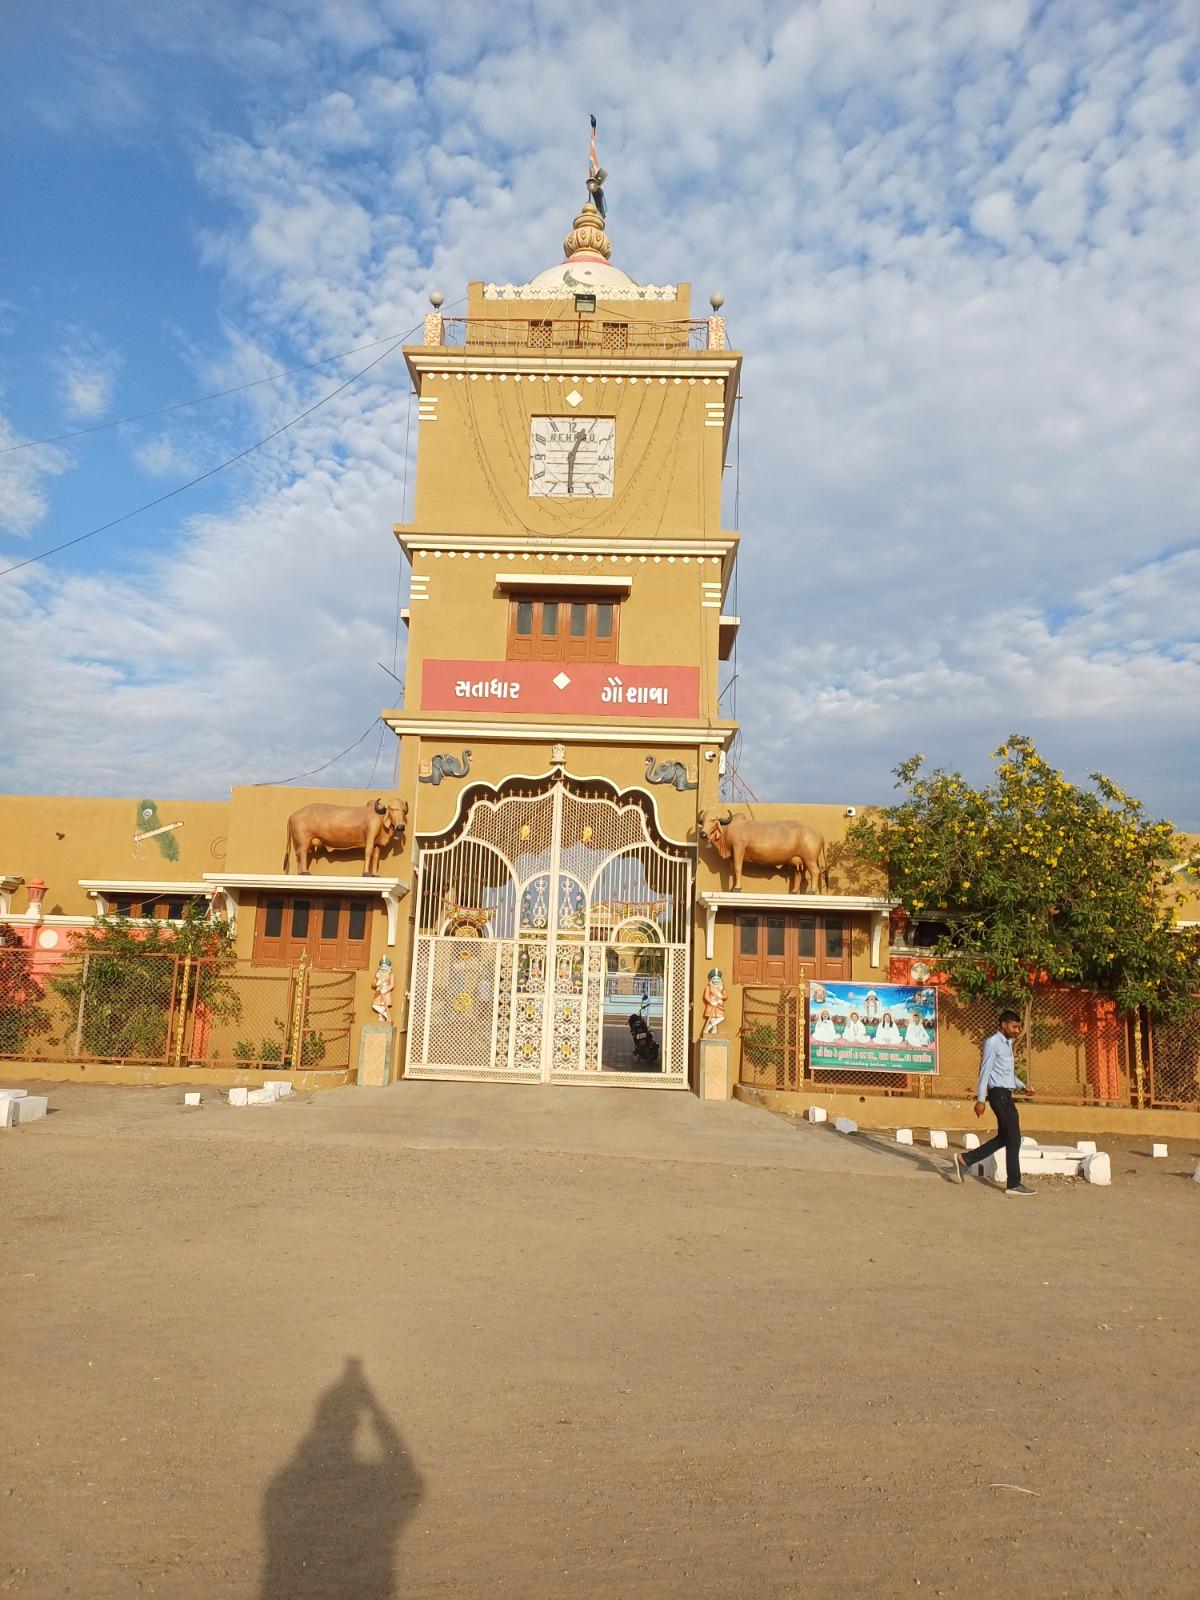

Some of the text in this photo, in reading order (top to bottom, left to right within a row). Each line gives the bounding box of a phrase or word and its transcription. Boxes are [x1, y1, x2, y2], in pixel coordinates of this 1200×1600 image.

[568, 422, 577, 433] 12
[550, 433, 595, 442] NEHU
[598, 472, 610, 482] 4
[549, 482, 558, 493] 7
[584, 482, 595, 494] 5
[454, 678, 521, 699] સતાધાર
